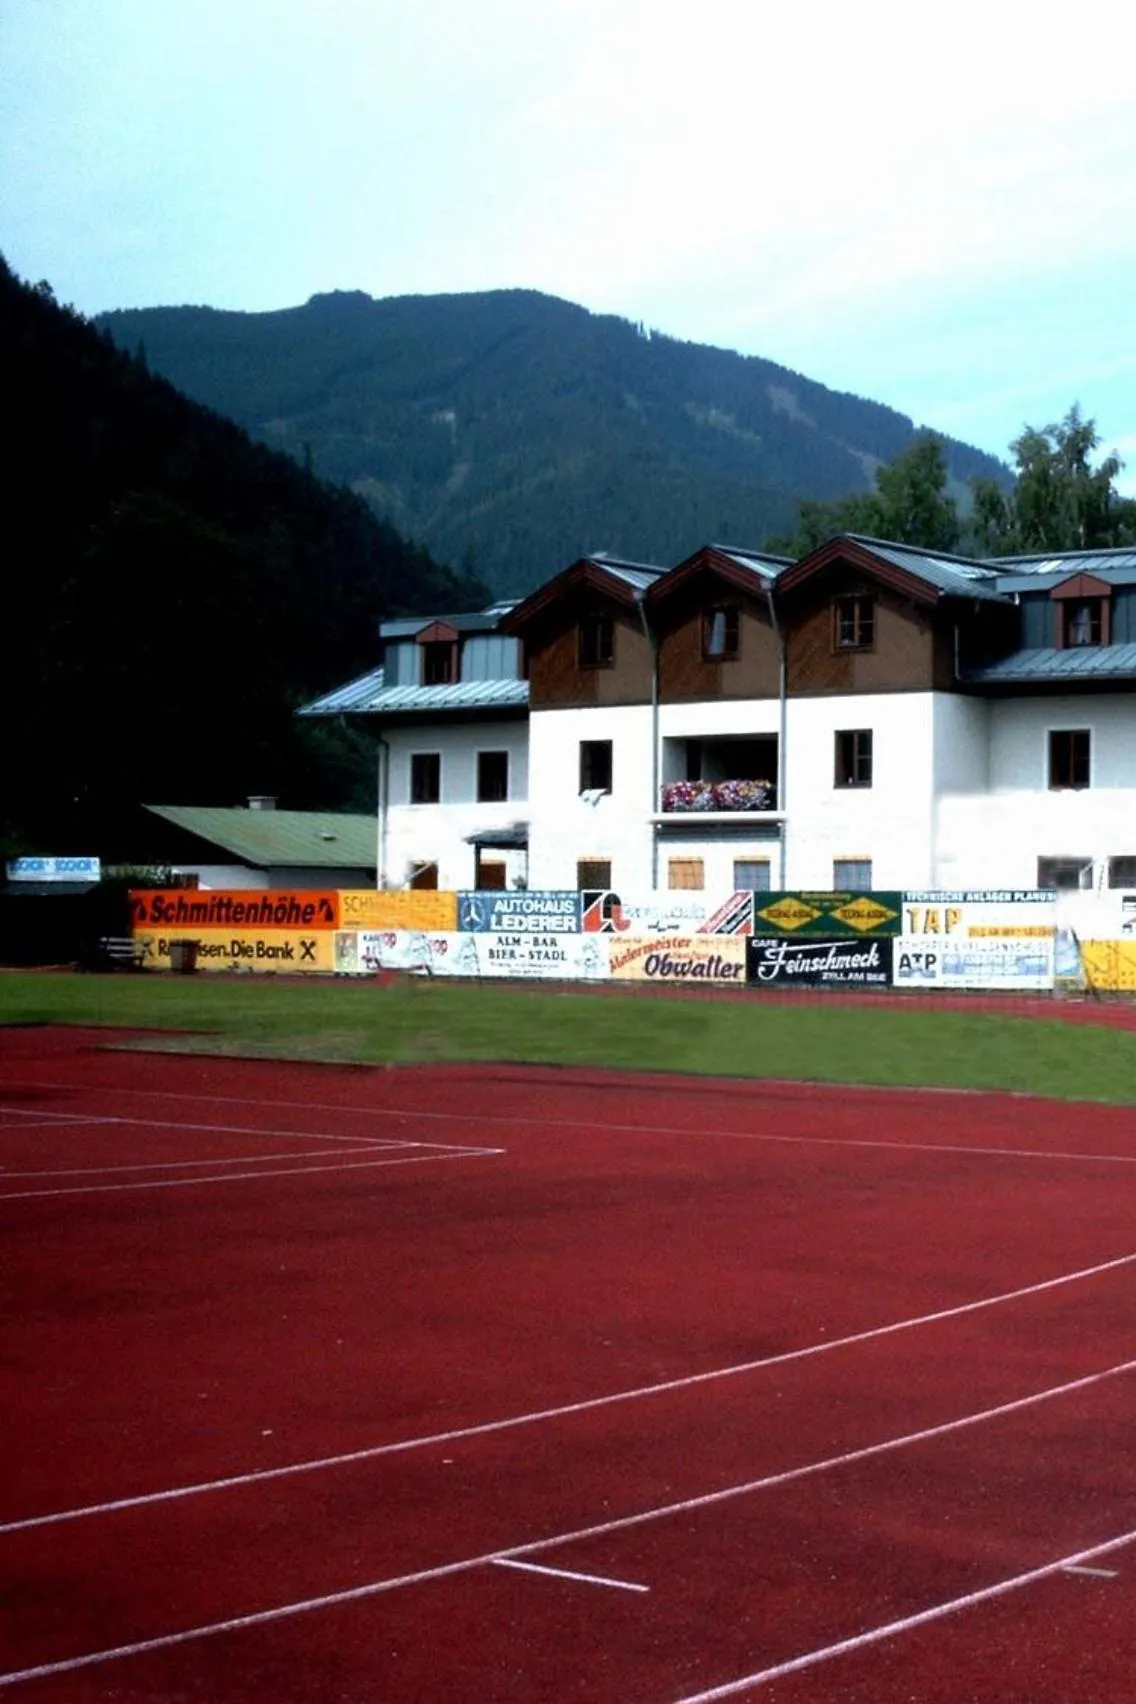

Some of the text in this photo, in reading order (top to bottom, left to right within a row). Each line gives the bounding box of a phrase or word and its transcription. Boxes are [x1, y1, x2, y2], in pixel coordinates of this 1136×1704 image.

[151, 895, 315, 925] Schmittenhöhe
[494, 900, 576, 914] AUTOHAUS
[490, 915, 577, 932] LEDERER
[906, 907, 962, 934] TAP
[256, 940, 294, 960] Bank
[497, 936, 558, 947] ALM BAR
[488, 949, 568, 962] BIER STADL
[898, 953, 937, 971] ATP
[644, 953, 745, 979] Obwaller
